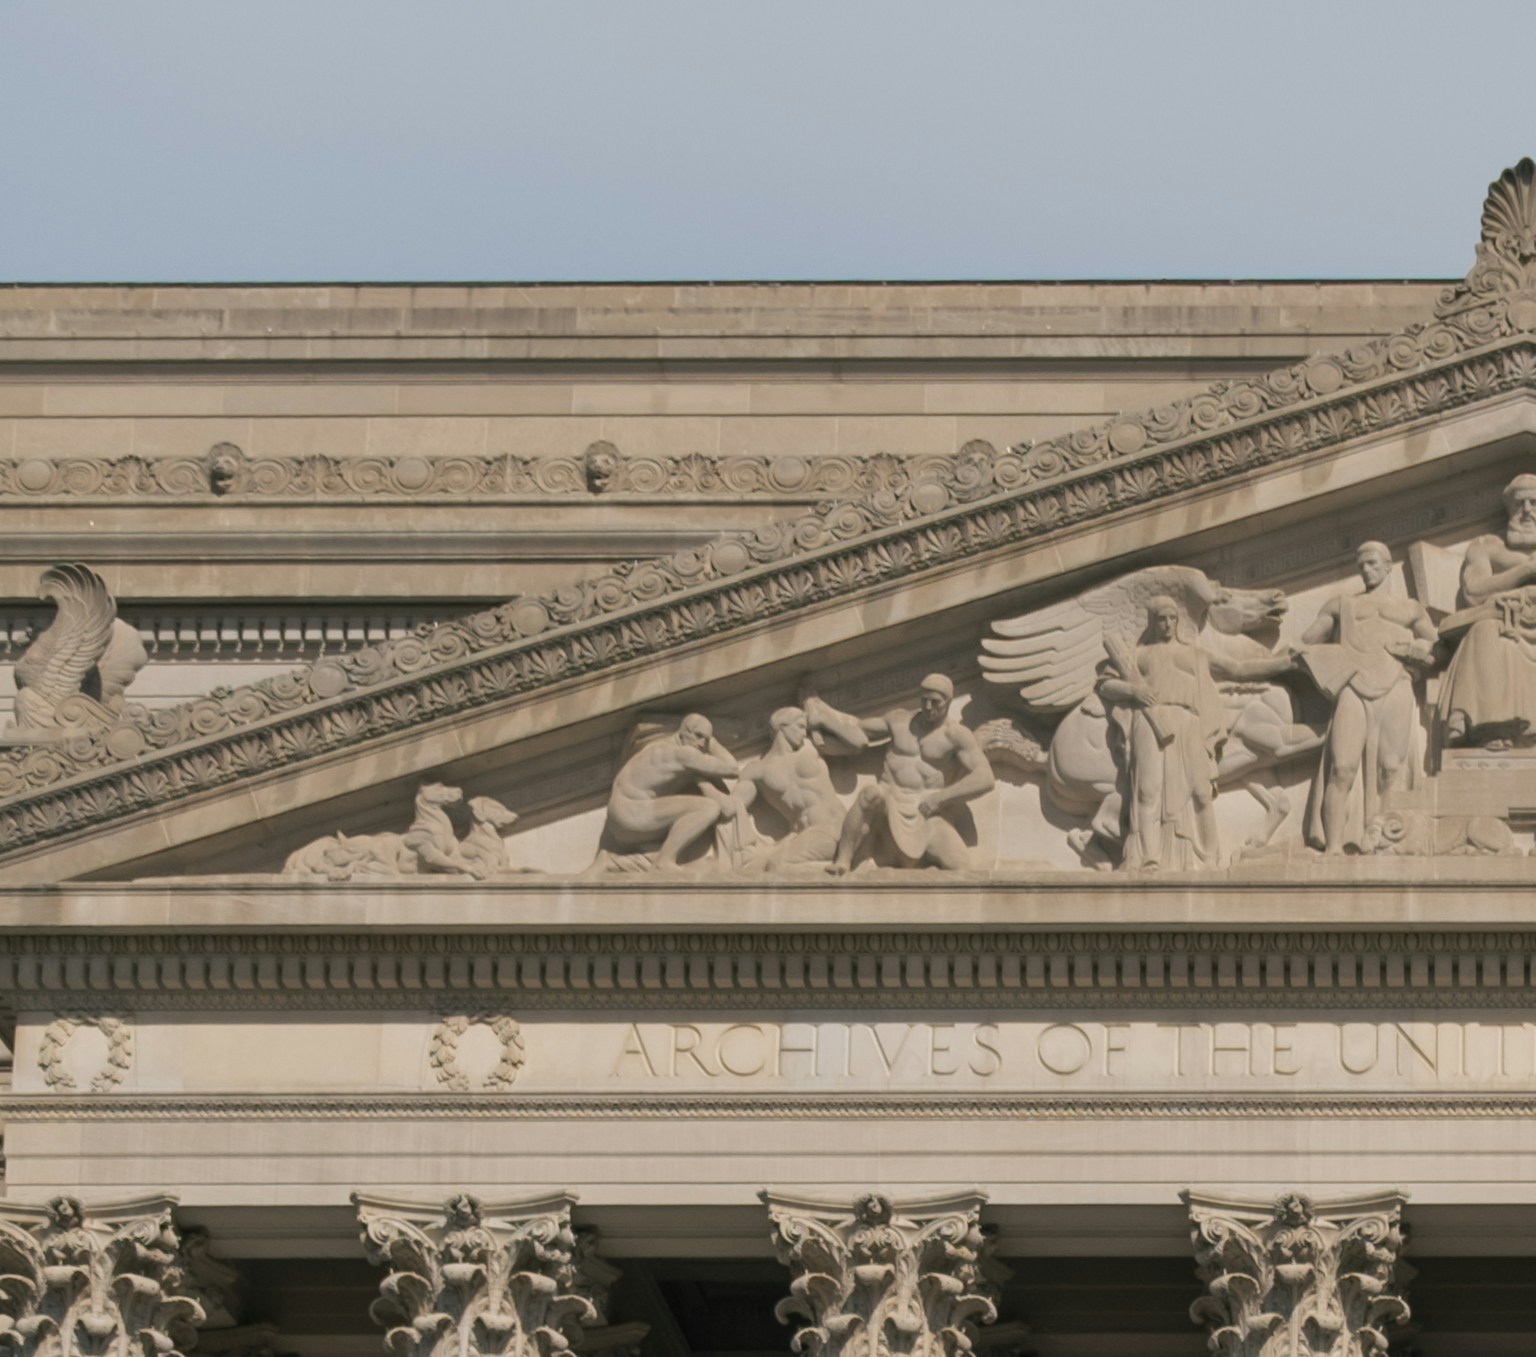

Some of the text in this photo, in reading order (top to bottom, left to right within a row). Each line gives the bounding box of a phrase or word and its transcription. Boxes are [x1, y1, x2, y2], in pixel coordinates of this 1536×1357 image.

[608, 1023, 1002, 1079] ARCHIVES
[1036, 1023, 1134, 1079] OF
[1157, 1022, 1303, 1079] THE
